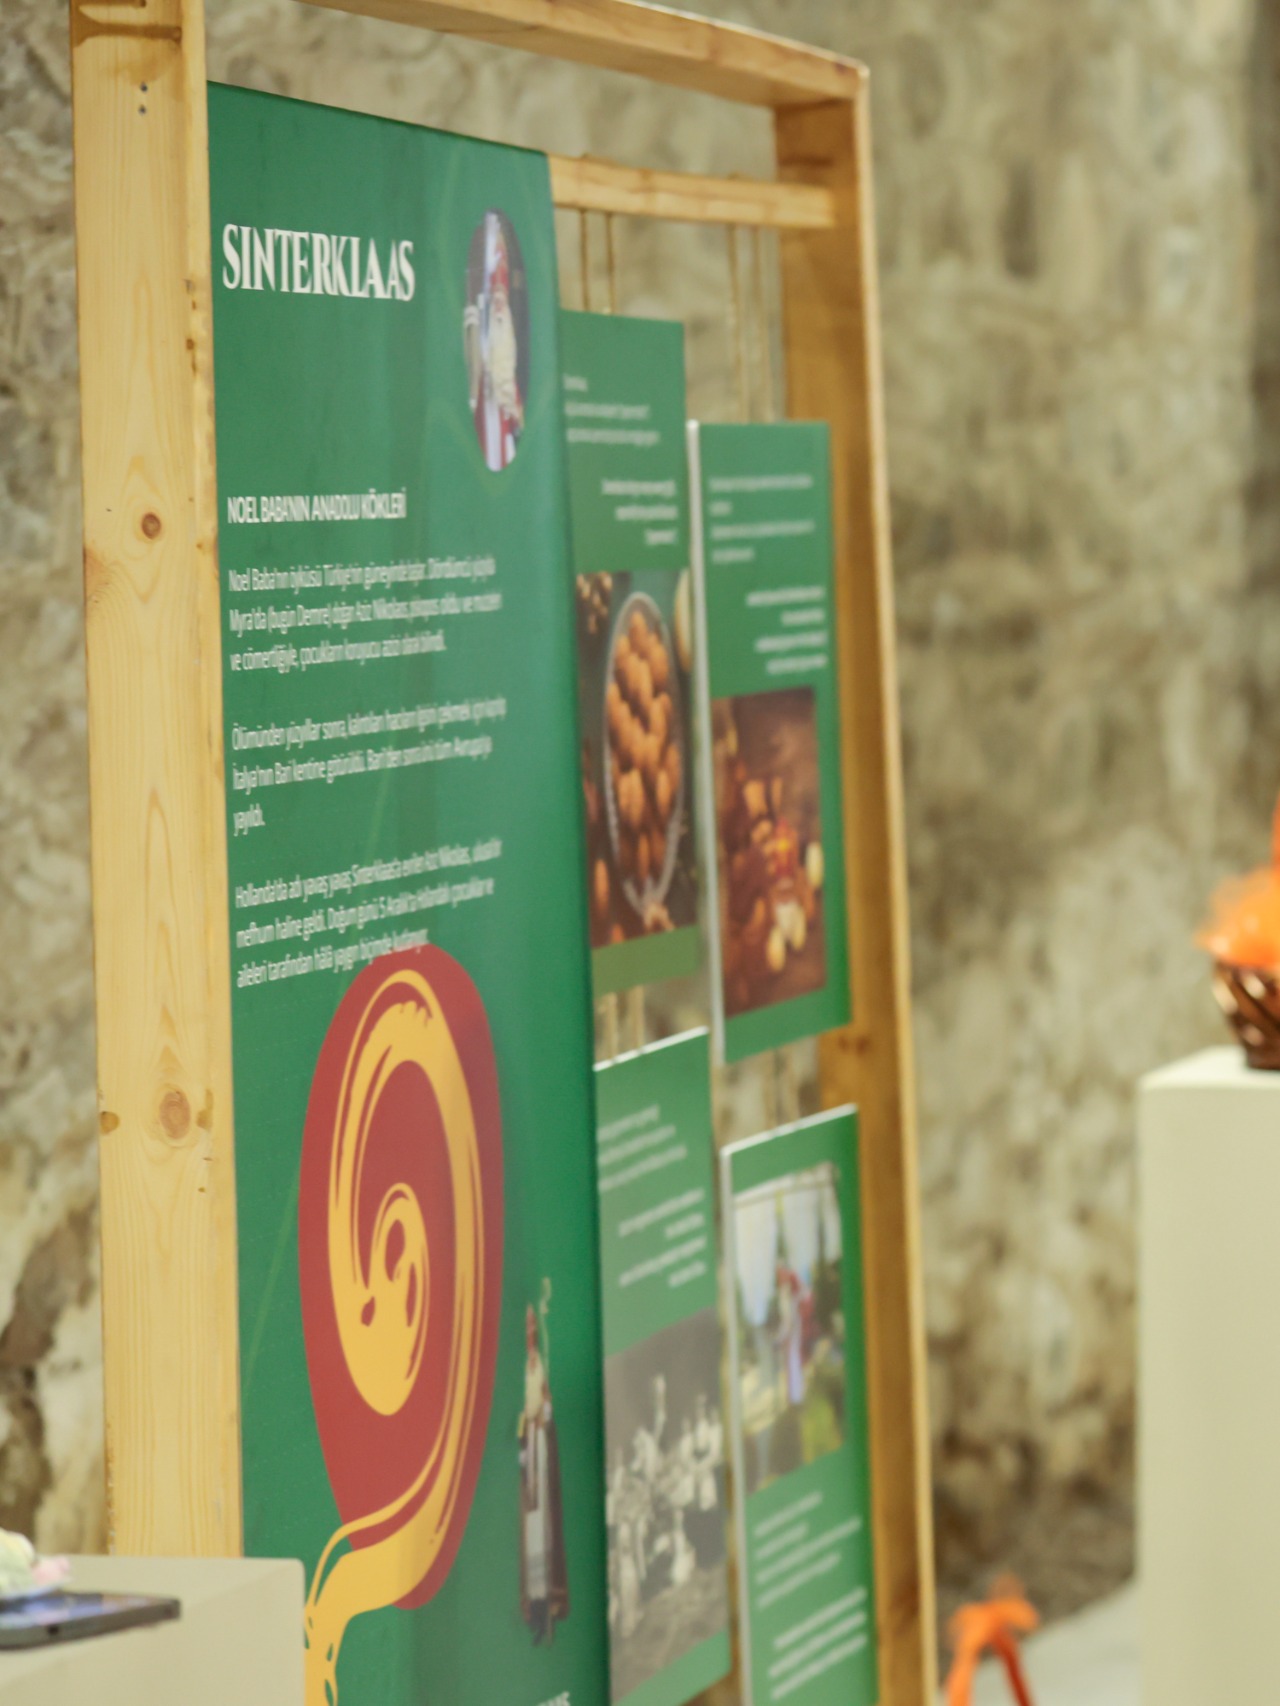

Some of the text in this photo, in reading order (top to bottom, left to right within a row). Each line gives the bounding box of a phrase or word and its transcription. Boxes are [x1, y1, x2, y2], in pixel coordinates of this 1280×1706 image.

[223, 224, 415, 301] SINTERKLAAS
[227, 496, 260, 524] NOEL
[229, 568, 251, 591] Noel
[230, 653, 243, 671] ve
[235, 878, 289, 908] Hollanda'da
